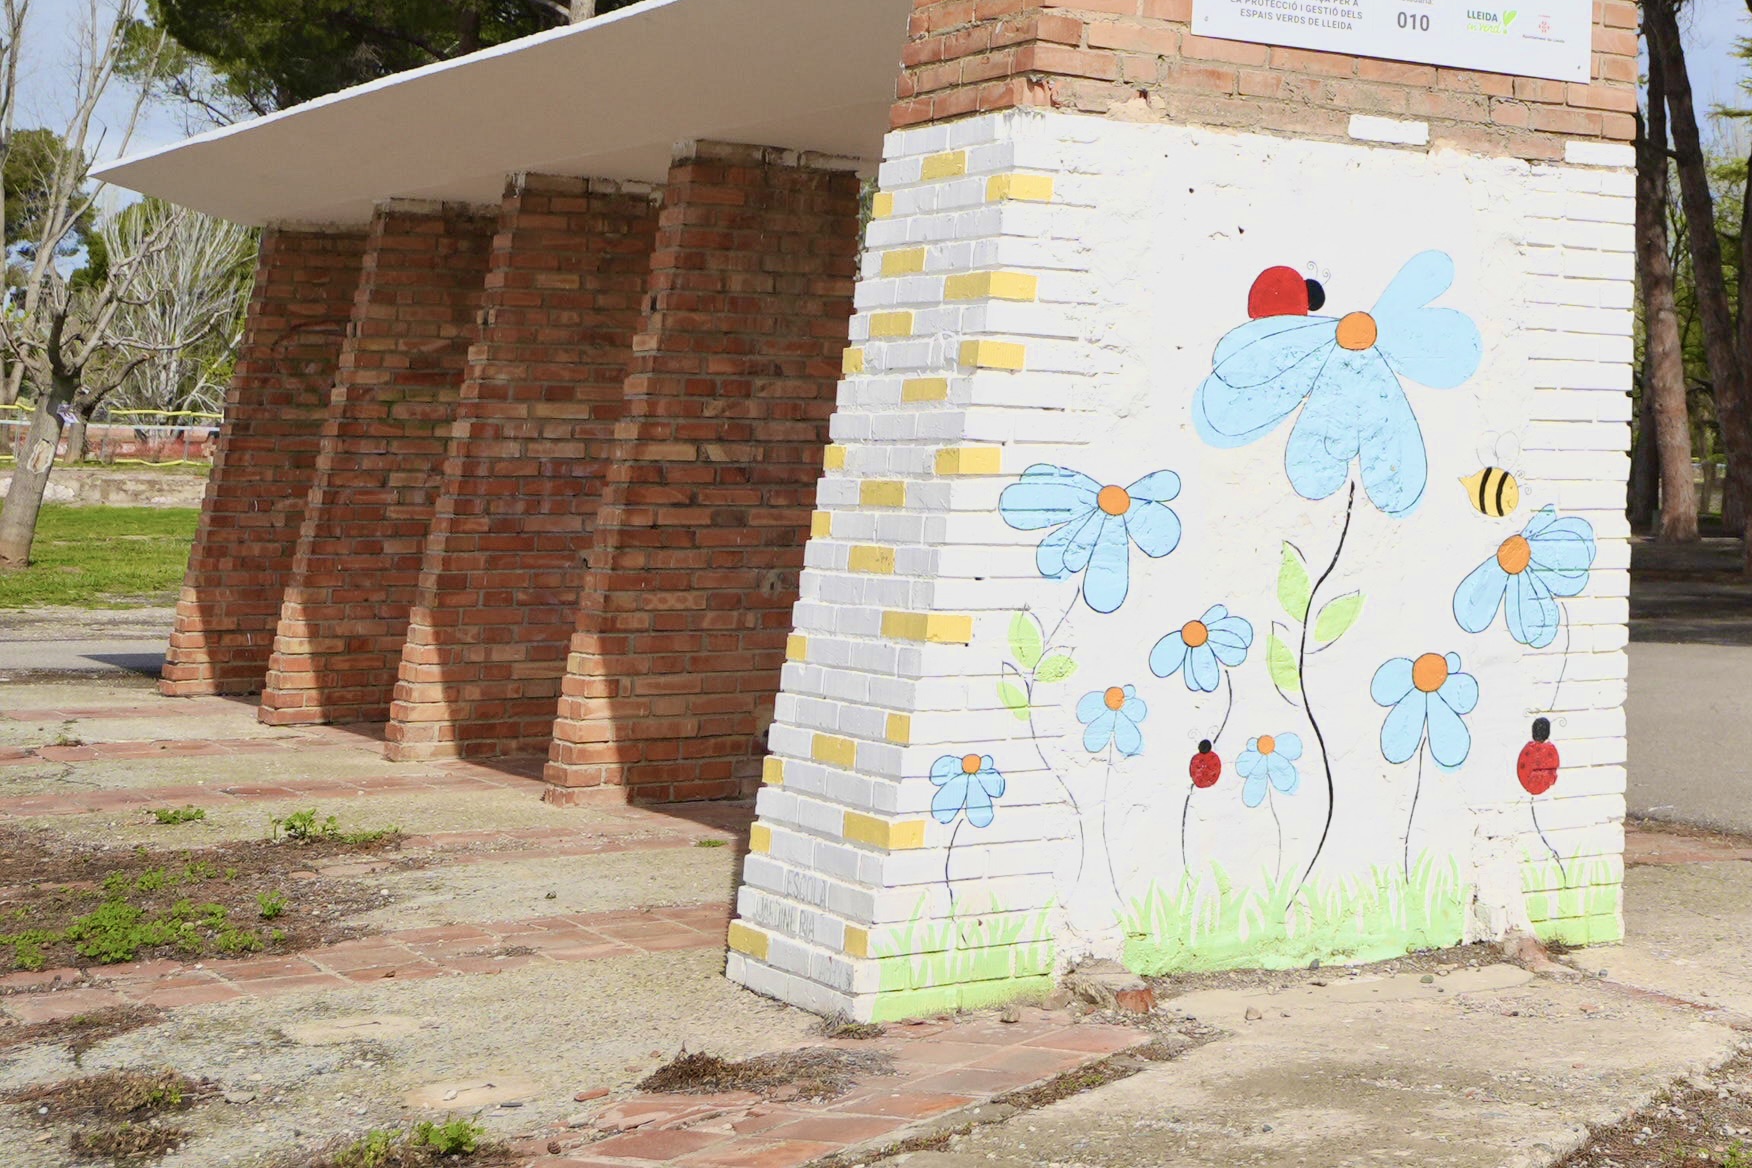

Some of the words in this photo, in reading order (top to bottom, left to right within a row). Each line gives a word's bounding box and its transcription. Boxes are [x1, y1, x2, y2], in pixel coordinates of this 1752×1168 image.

[1352, 0, 1358, 7] A
[1306, 4, 1338, 17] GESTIÓ
[1341, 9, 1362, 19] DELS
[1467, 9, 1498, 22] LLEIDA
[1240, 9, 1273, 21] ESPAIS
[1276, 13, 1305, 24] VERDS
[1308, 18, 1319, 27] DE
[1321, 19, 1352, 30] LLEIDA
[1397, 11, 1429, 31] 010
